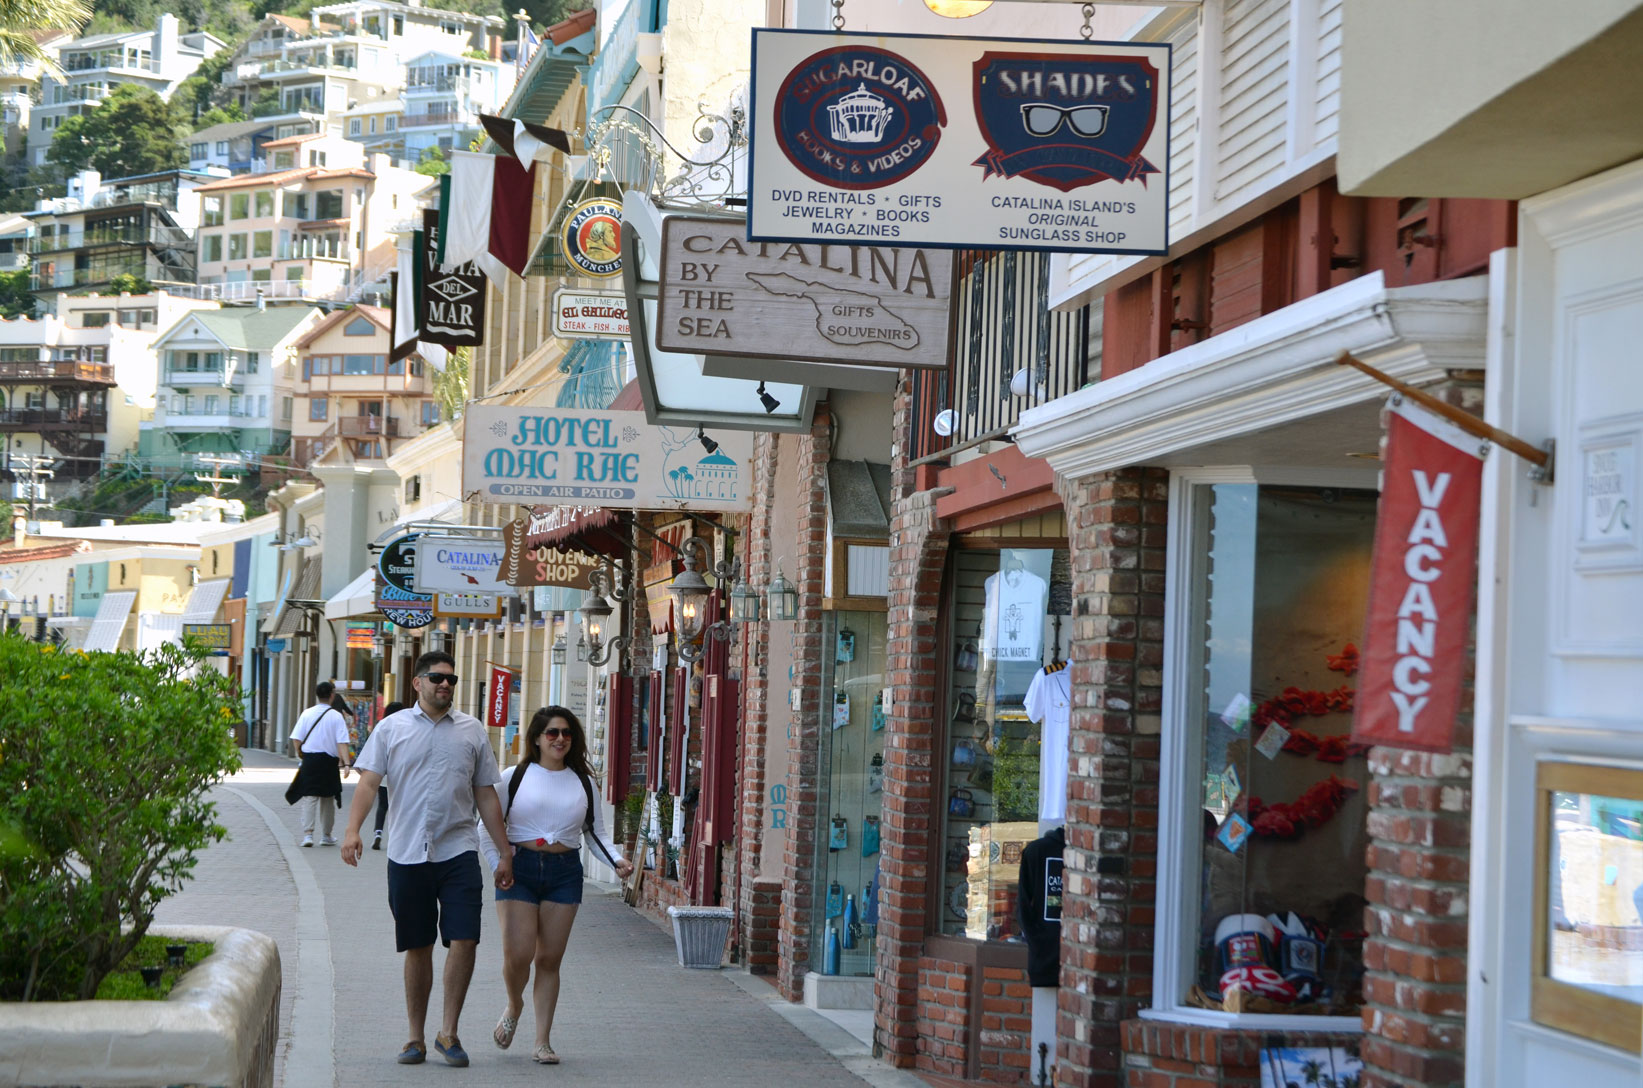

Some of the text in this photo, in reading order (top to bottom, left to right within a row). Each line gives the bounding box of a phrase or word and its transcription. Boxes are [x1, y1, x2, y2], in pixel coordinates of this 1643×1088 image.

[794, 59, 926, 104] SUGARLOAF
[998, 71, 1136, 98] SHADES
[851, 162, 863, 174] &
[868, 135, 922, 174] VIDEOS
[771, 189, 942, 209] DVD RENTALS GIFTS
[991, 196, 1136, 215] CATALINA ISLAND'S
[570, 205, 623, 230] PAULAN
[782, 205, 930, 223] JEWELRY BOOKS
[1027, 212, 1099, 228] ORIGINAL
[811, 221, 901, 237] MAGAZINES
[998, 226, 1127, 244] SUNGLASS SHOP
[573, 252, 622, 273] MÜNCHE
[680, 262, 720, 282] BY
[682, 235, 936, 299] CATALINA
[442, 282, 463, 295] DEL
[575, 297, 597, 306] MEET
[600, 298, 612, 306] ME
[678, 289, 734, 311] THE
[428, 300, 474, 326] MAR
[562, 306, 629, 320] EL GALLEO
[831, 304, 875, 319] GIFTS
[563, 321, 630, 333] STEAK FISH RIB
[677, 316, 733, 339] SEA
[826, 324, 912, 341] SOUVENIRS
[511, 415, 618, 449] HOTEL
[483, 447, 640, 484] MAC RAE
[500, 484, 625, 500] OPEN AIR PATIO
[436, 549, 499, 566] CATALINA
[535, 562, 579, 582] SHOP
[443, 598, 491, 608] GULLS
[1389, 469, 1452, 733] VACANCY
[494, 674, 506, 724] VACANCY
